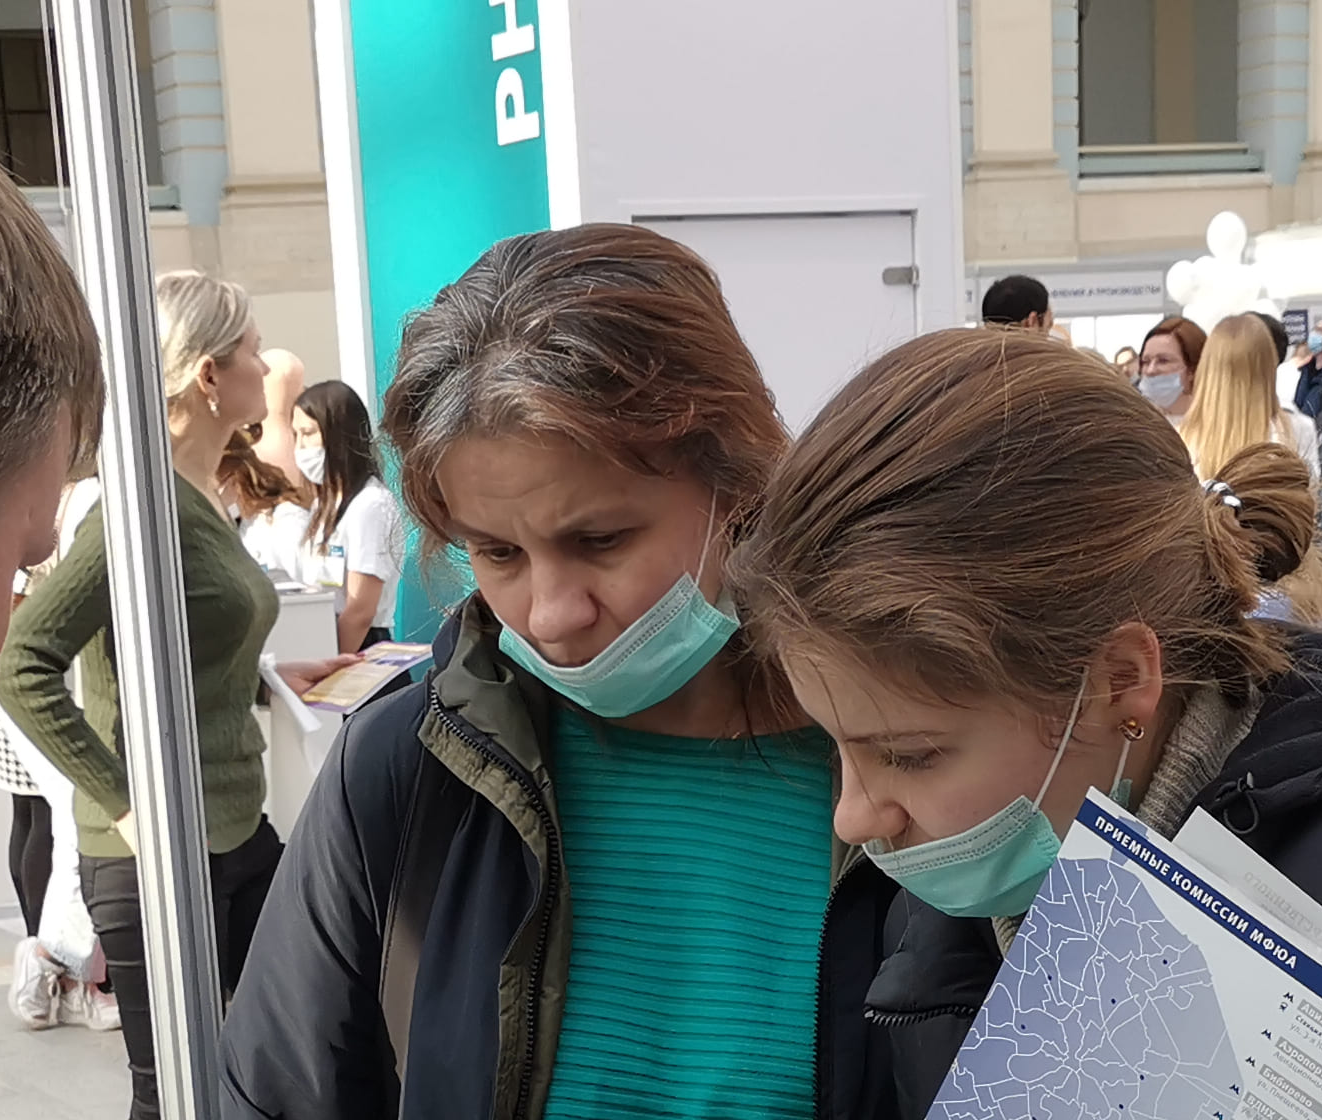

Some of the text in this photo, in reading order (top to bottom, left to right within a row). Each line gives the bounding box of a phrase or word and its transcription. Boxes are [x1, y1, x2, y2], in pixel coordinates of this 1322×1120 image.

[1092, 815, 1300, 969] ПРИЕМНЫЕ КОМИССИИ МФЮА
[1245, 1094, 1276, 1120] ВДНХ
[1260, 1067, 1315, 1108] Бибирево
